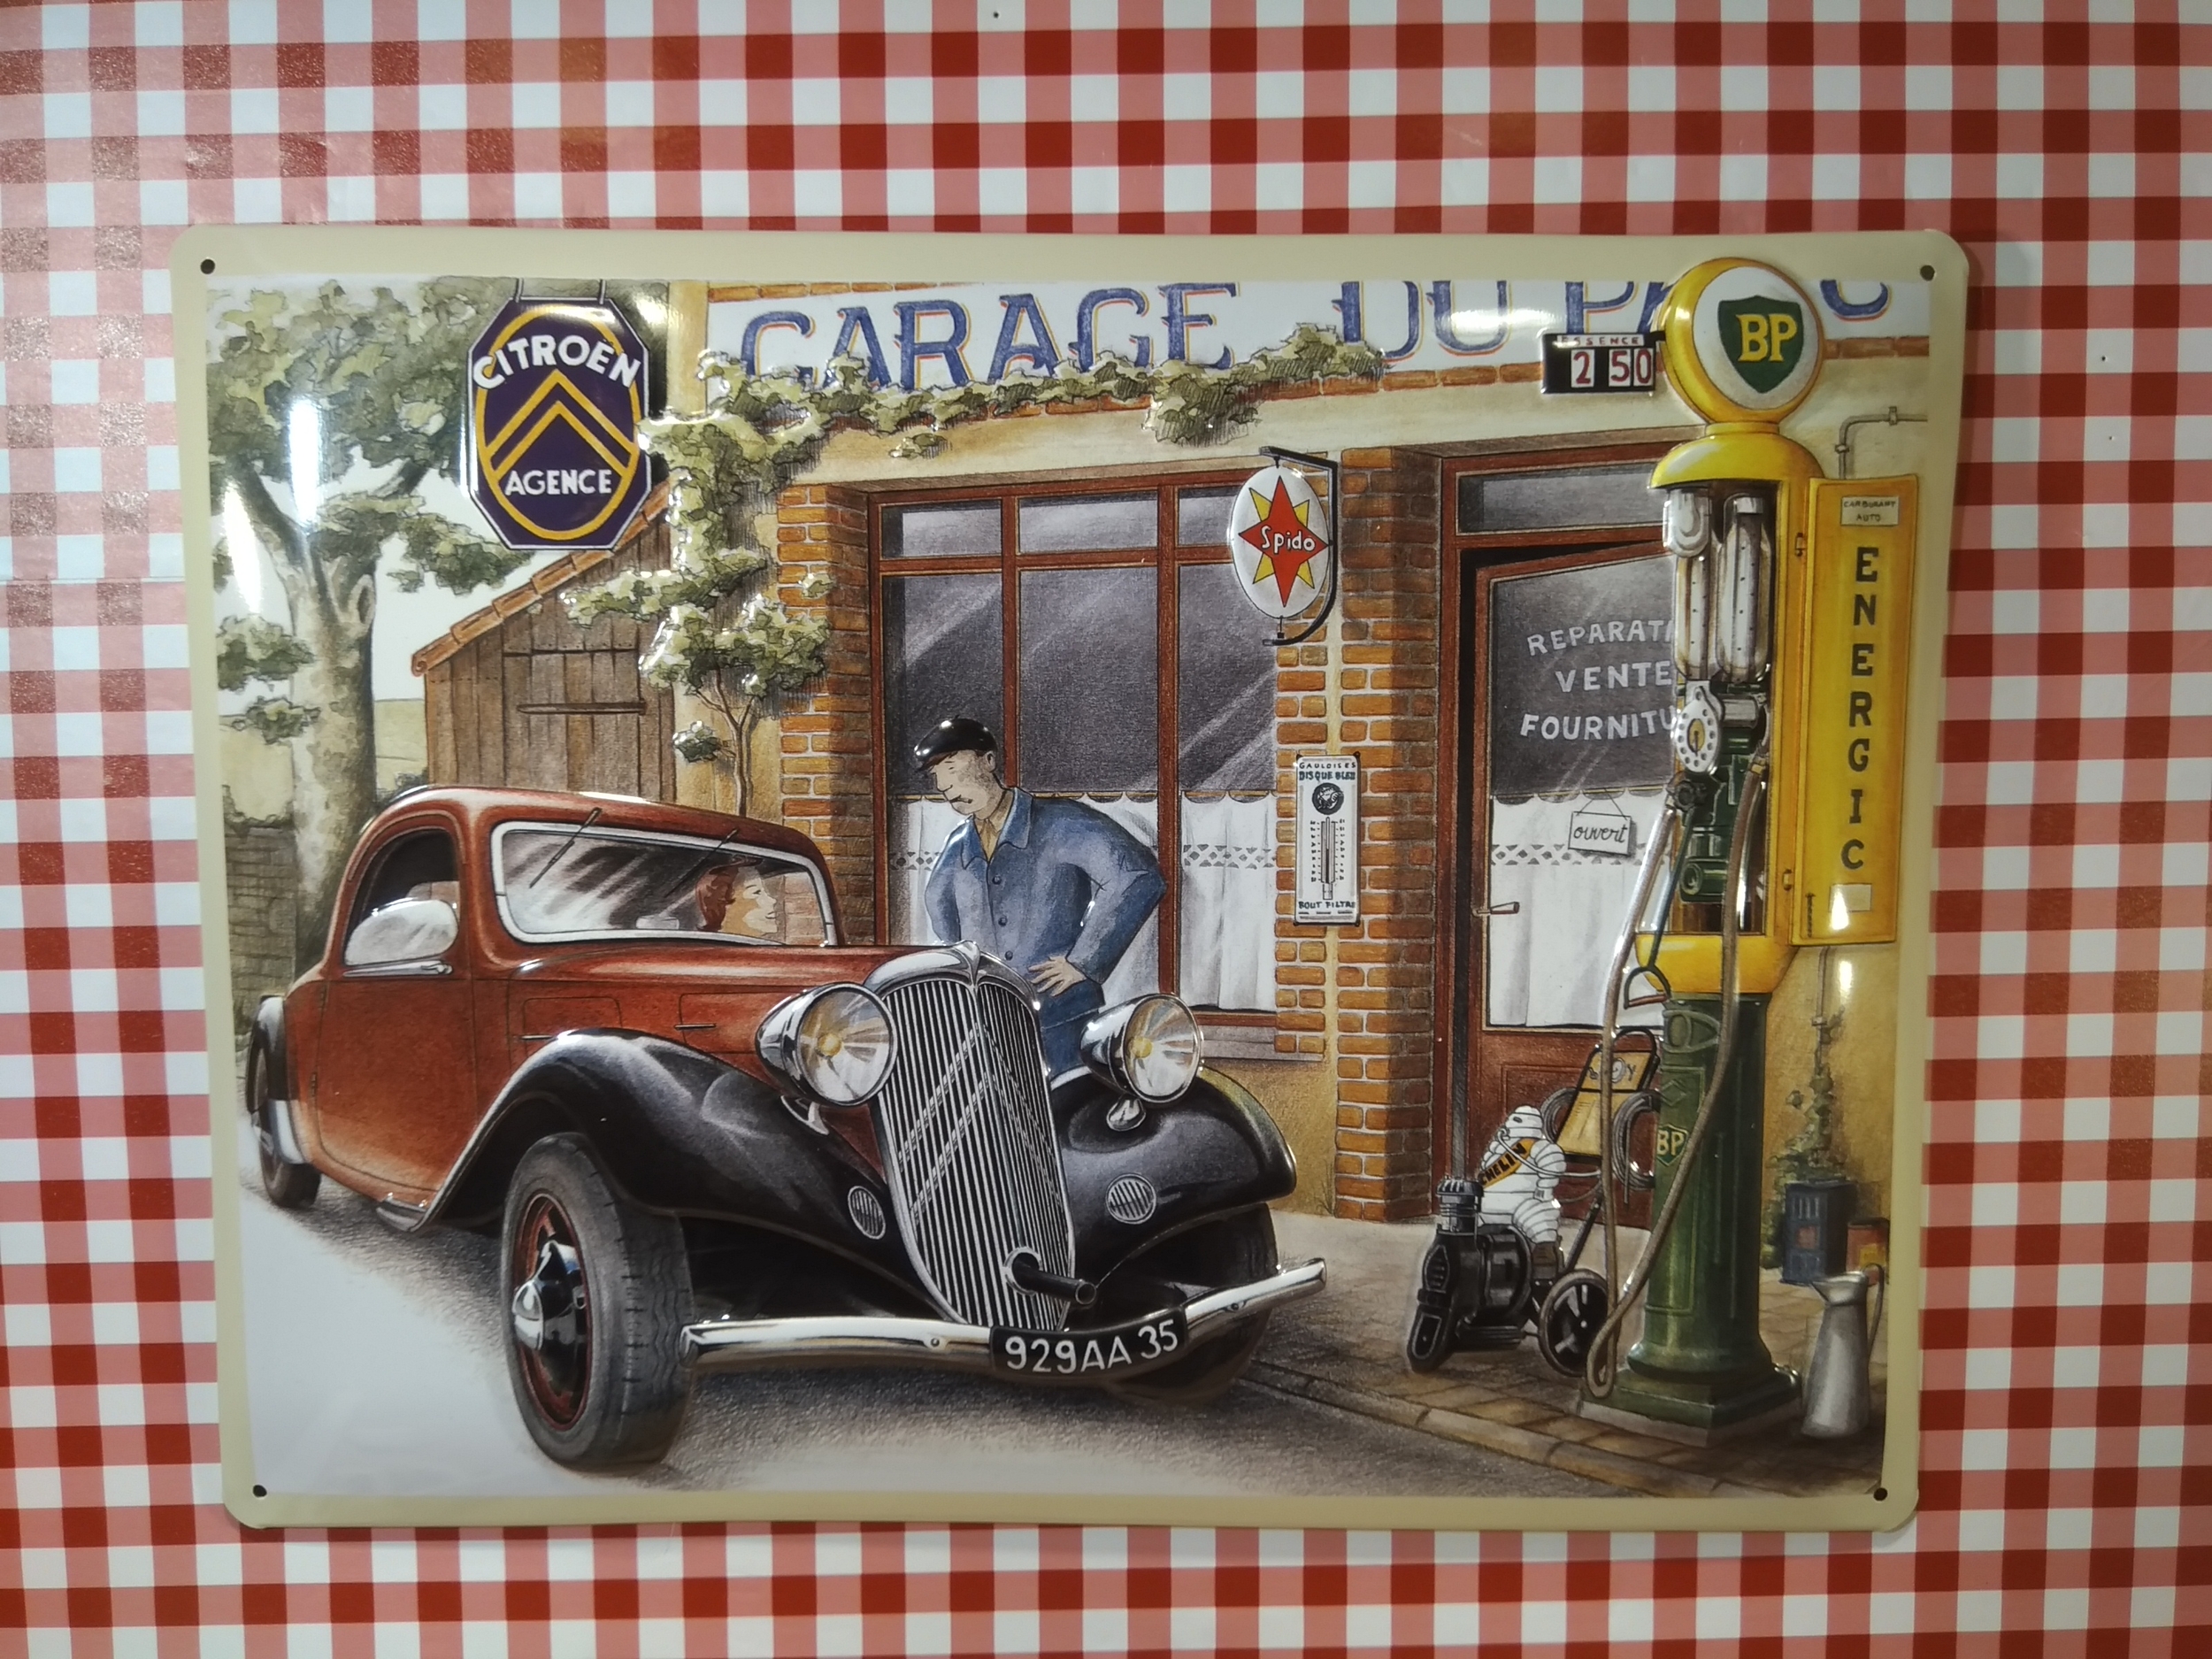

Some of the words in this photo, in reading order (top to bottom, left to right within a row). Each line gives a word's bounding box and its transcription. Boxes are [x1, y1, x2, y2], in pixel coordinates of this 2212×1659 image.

[740, 281, 1239, 391] GARAGE
[1735, 313, 1797, 363] BP
[504, 469, 612, 495] AGENCE
[1261, 526, 1316, 554] Spido
[1555, 660, 1672, 693] VENTE
[1840, 546, 1879, 870] ENERGIC
[1299, 771, 1333, 782] DISQUE
[1572, 820, 1629, 843] ouvert
[1298, 901, 1322, 910] BOUT
[1656, 1130, 1685, 1156] BP
[1478, 1142, 1527, 1186] CHELIN
